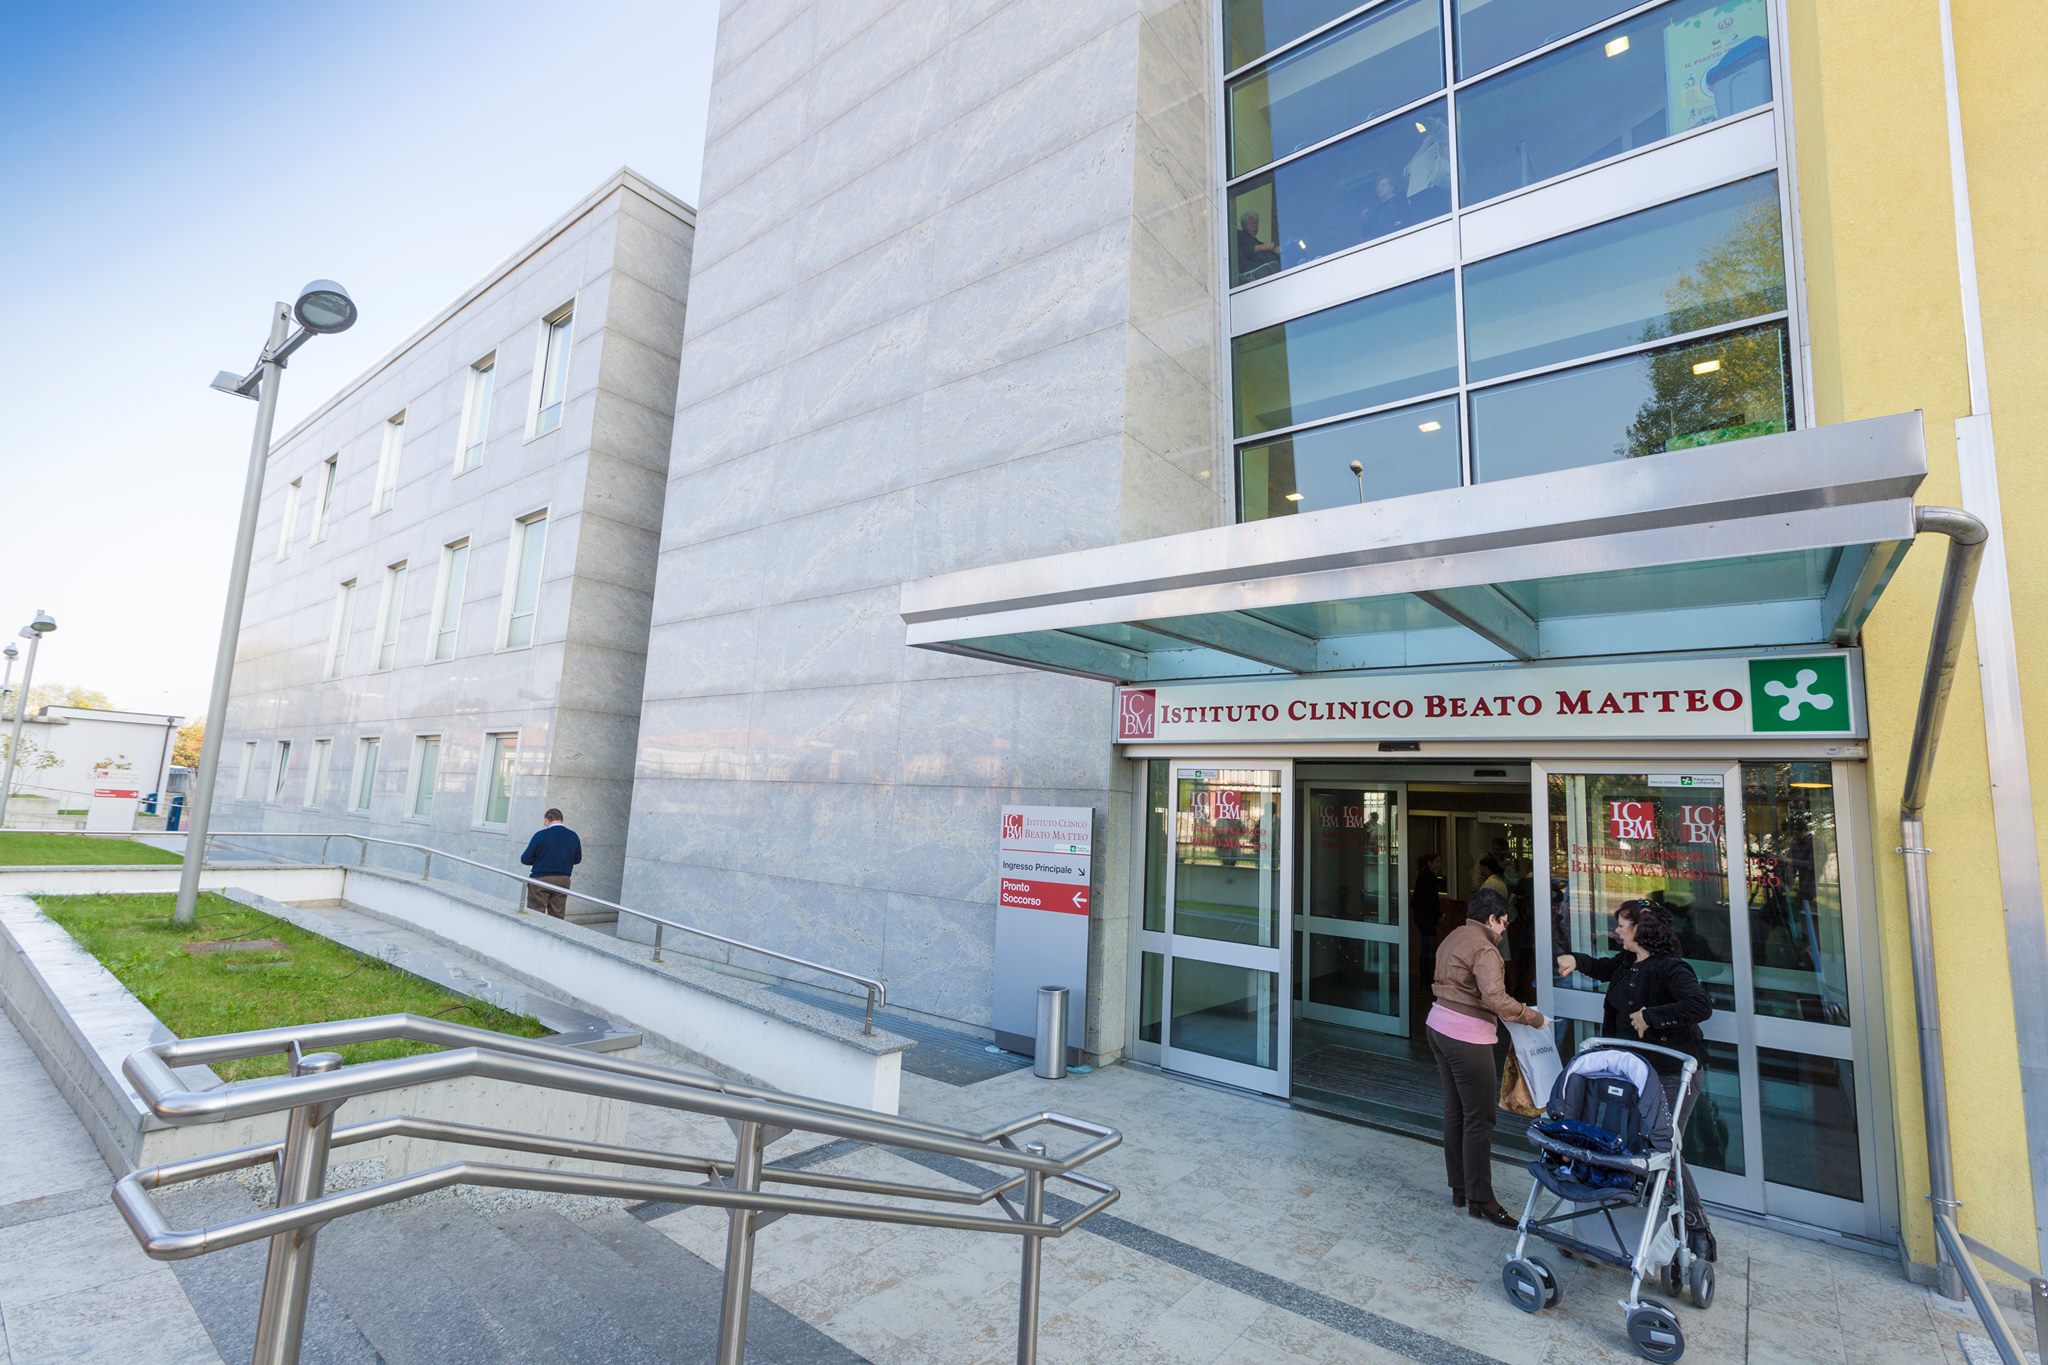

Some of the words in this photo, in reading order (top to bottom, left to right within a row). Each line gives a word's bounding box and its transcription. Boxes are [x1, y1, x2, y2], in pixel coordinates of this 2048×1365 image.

[1161, 704, 1279, 724] ISTITUTO
[1288, 700, 1414, 722] CLINICO
[1424, 695, 1543, 718] BEATO
[1555, 688, 1744, 715] MATTEO
[1026, 818, 1058, 828] ISTITUTO
[1058, 819, 1087, 828] CLINICO
[1025, 829, 1050, 840] BEATO
[1052, 830, 1088, 841] MATTEO
[1003, 861, 1033, 871] Ingresso
[1035, 863, 1072, 874] Principale
[1003, 881, 1030, 892] Pronto
[1003, 893, 1041, 906] Soccorso
